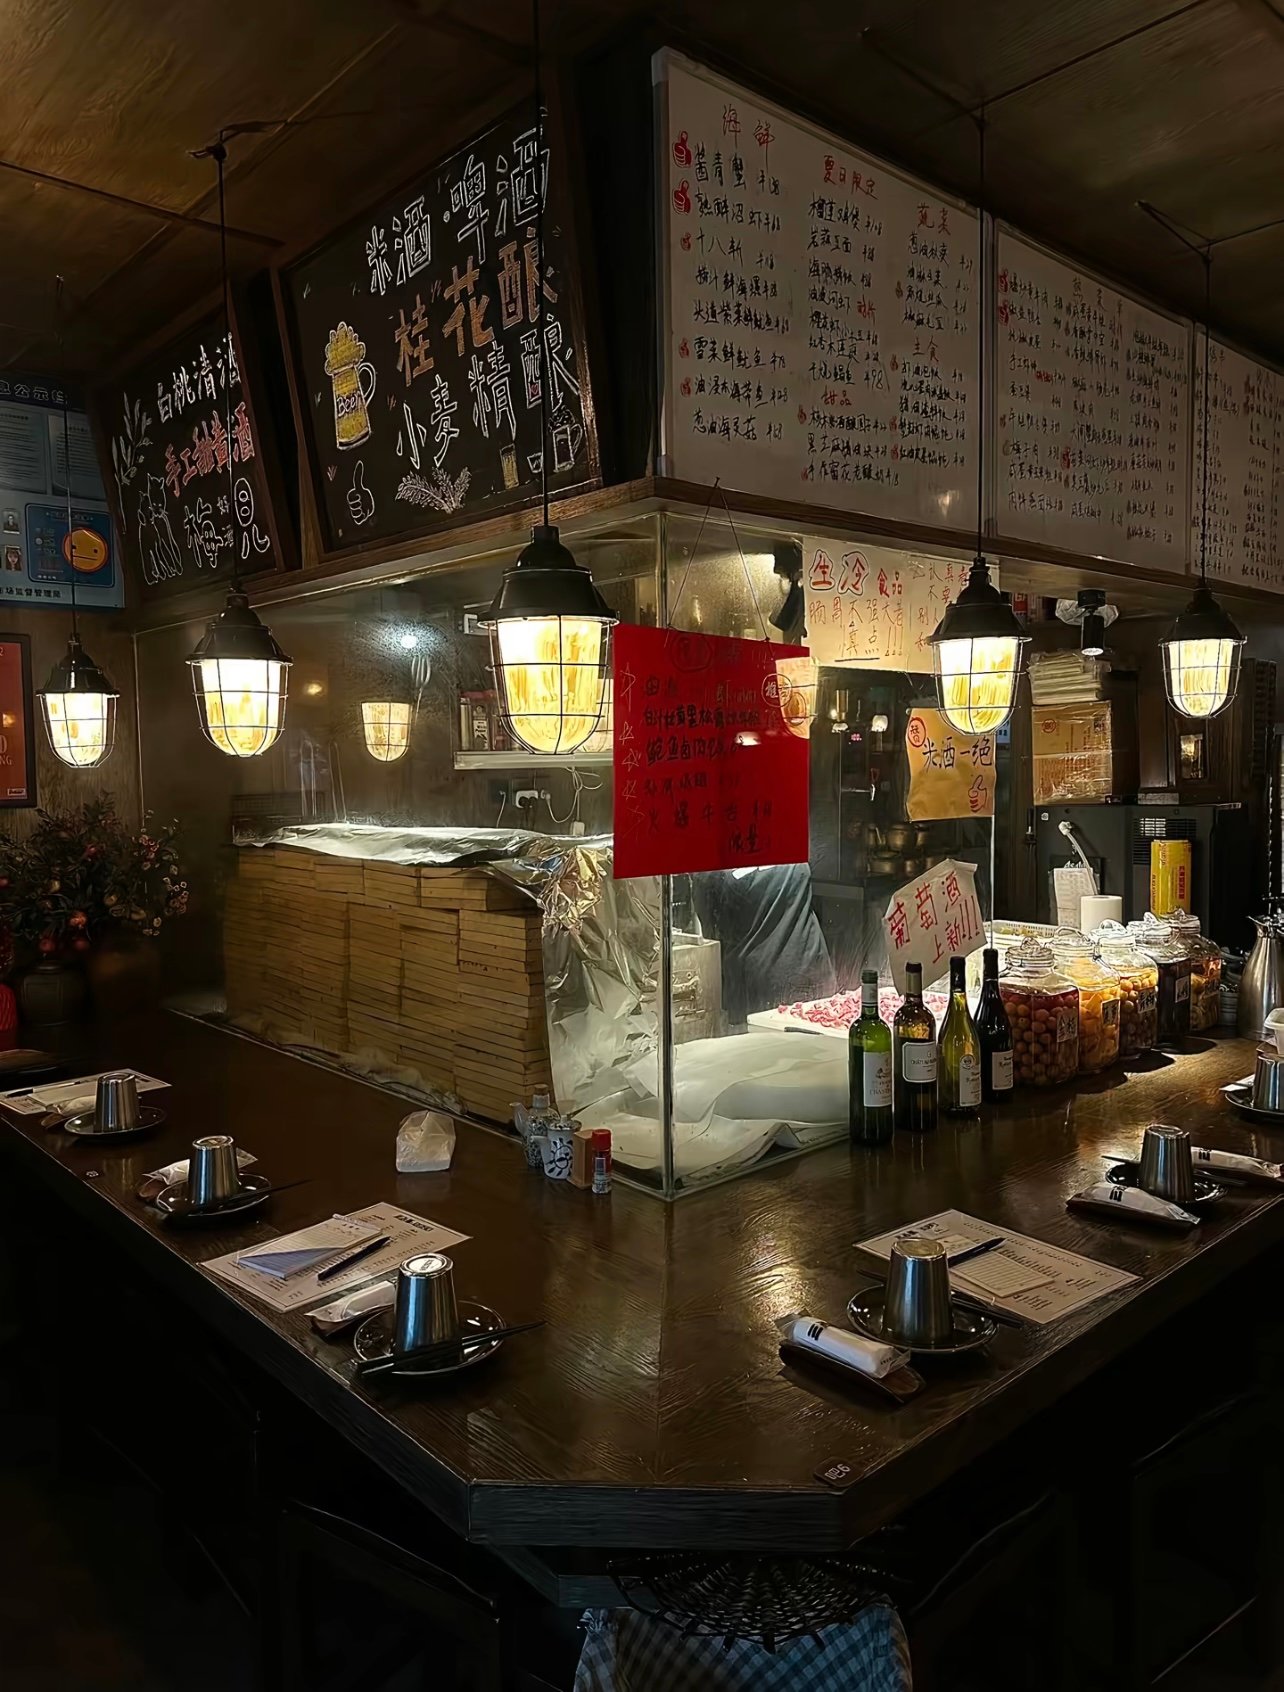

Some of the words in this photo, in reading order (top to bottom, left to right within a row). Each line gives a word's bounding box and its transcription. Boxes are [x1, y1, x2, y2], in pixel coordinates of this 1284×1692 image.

[824, 155, 879, 201] 夏日限定
[395, 227, 558, 389] 桂花酿
[694, 336, 767, 370] 雪菜鲜鱿鱼
[913, 335, 940, 363] 主食
[157, 331, 242, 424] 白桃清酒
[396, 313, 580, 470] 小麦精酿
[821, 385, 852, 407] 甜品
[337, 393, 362, 418] Beer
[809, 549, 903, 599] 生冷食品
[922, 736, 993, 771] 米酒一绝
[888, 871, 962, 951] 葡萄酒
